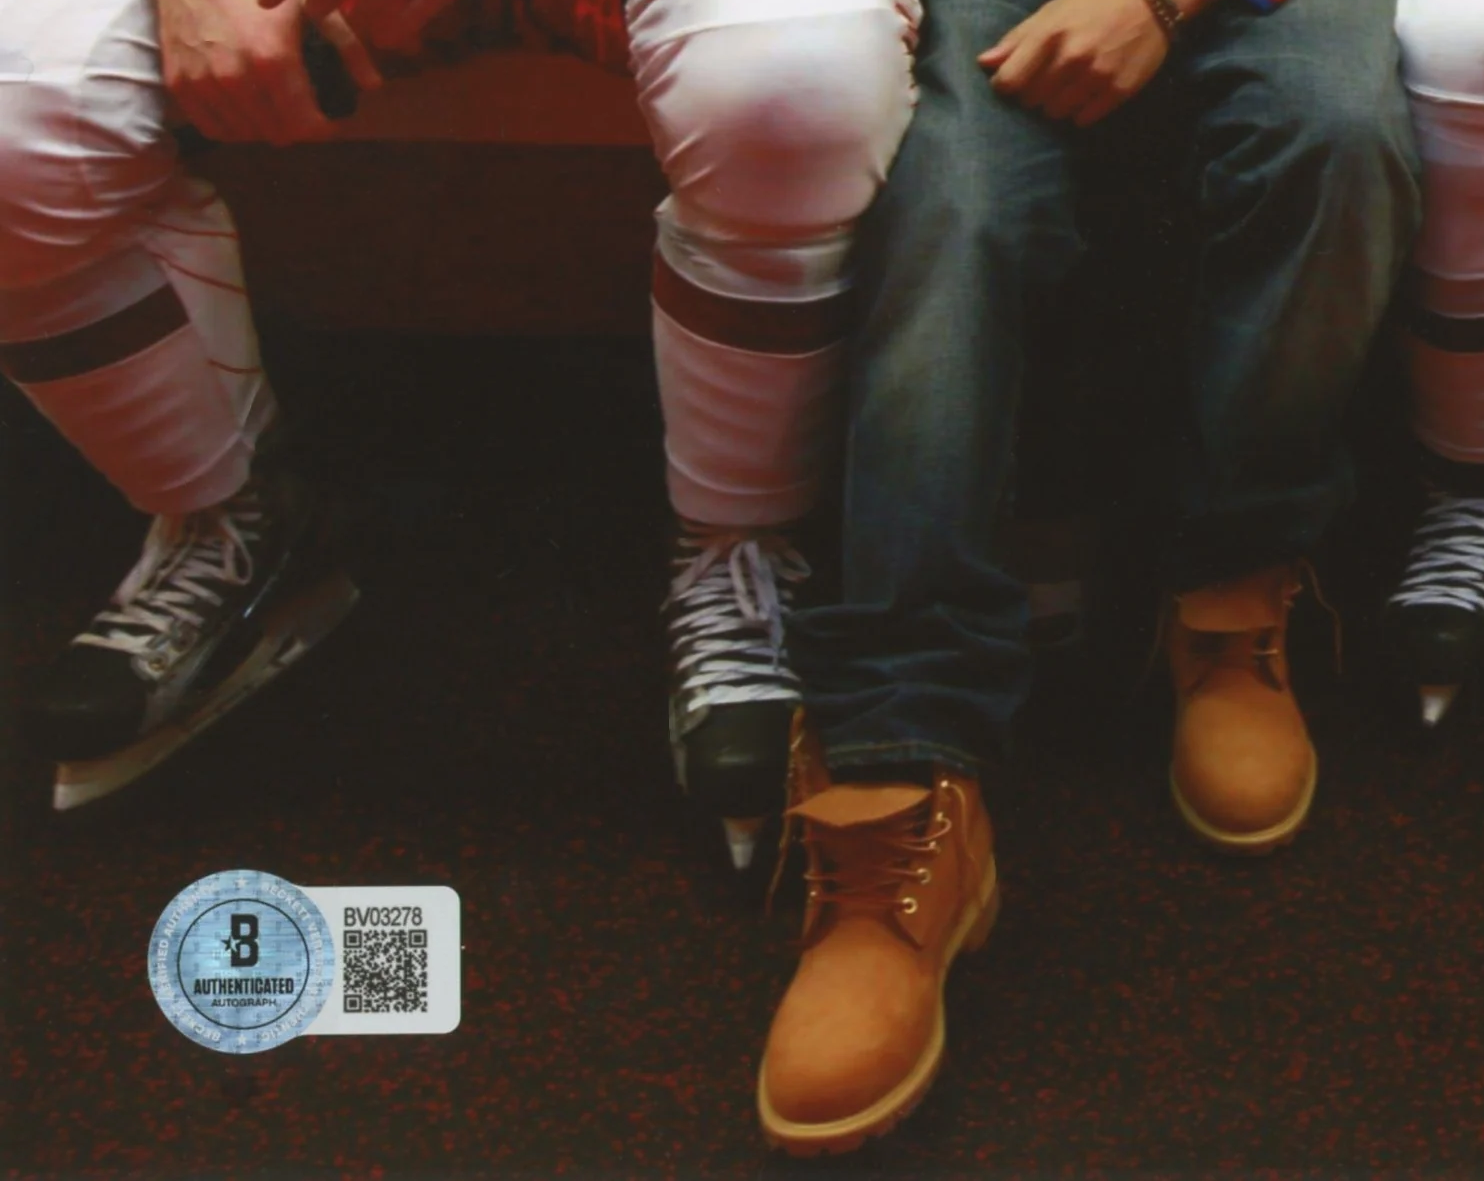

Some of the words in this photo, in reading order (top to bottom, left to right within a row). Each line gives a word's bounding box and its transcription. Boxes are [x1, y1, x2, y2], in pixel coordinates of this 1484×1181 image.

[344, 907, 422, 927] BV03278
[231, 914, 259, 967] B
[194, 977, 294, 995] AUTHENTICATED
[211, 997, 277, 1007] AUTOGRAPH
